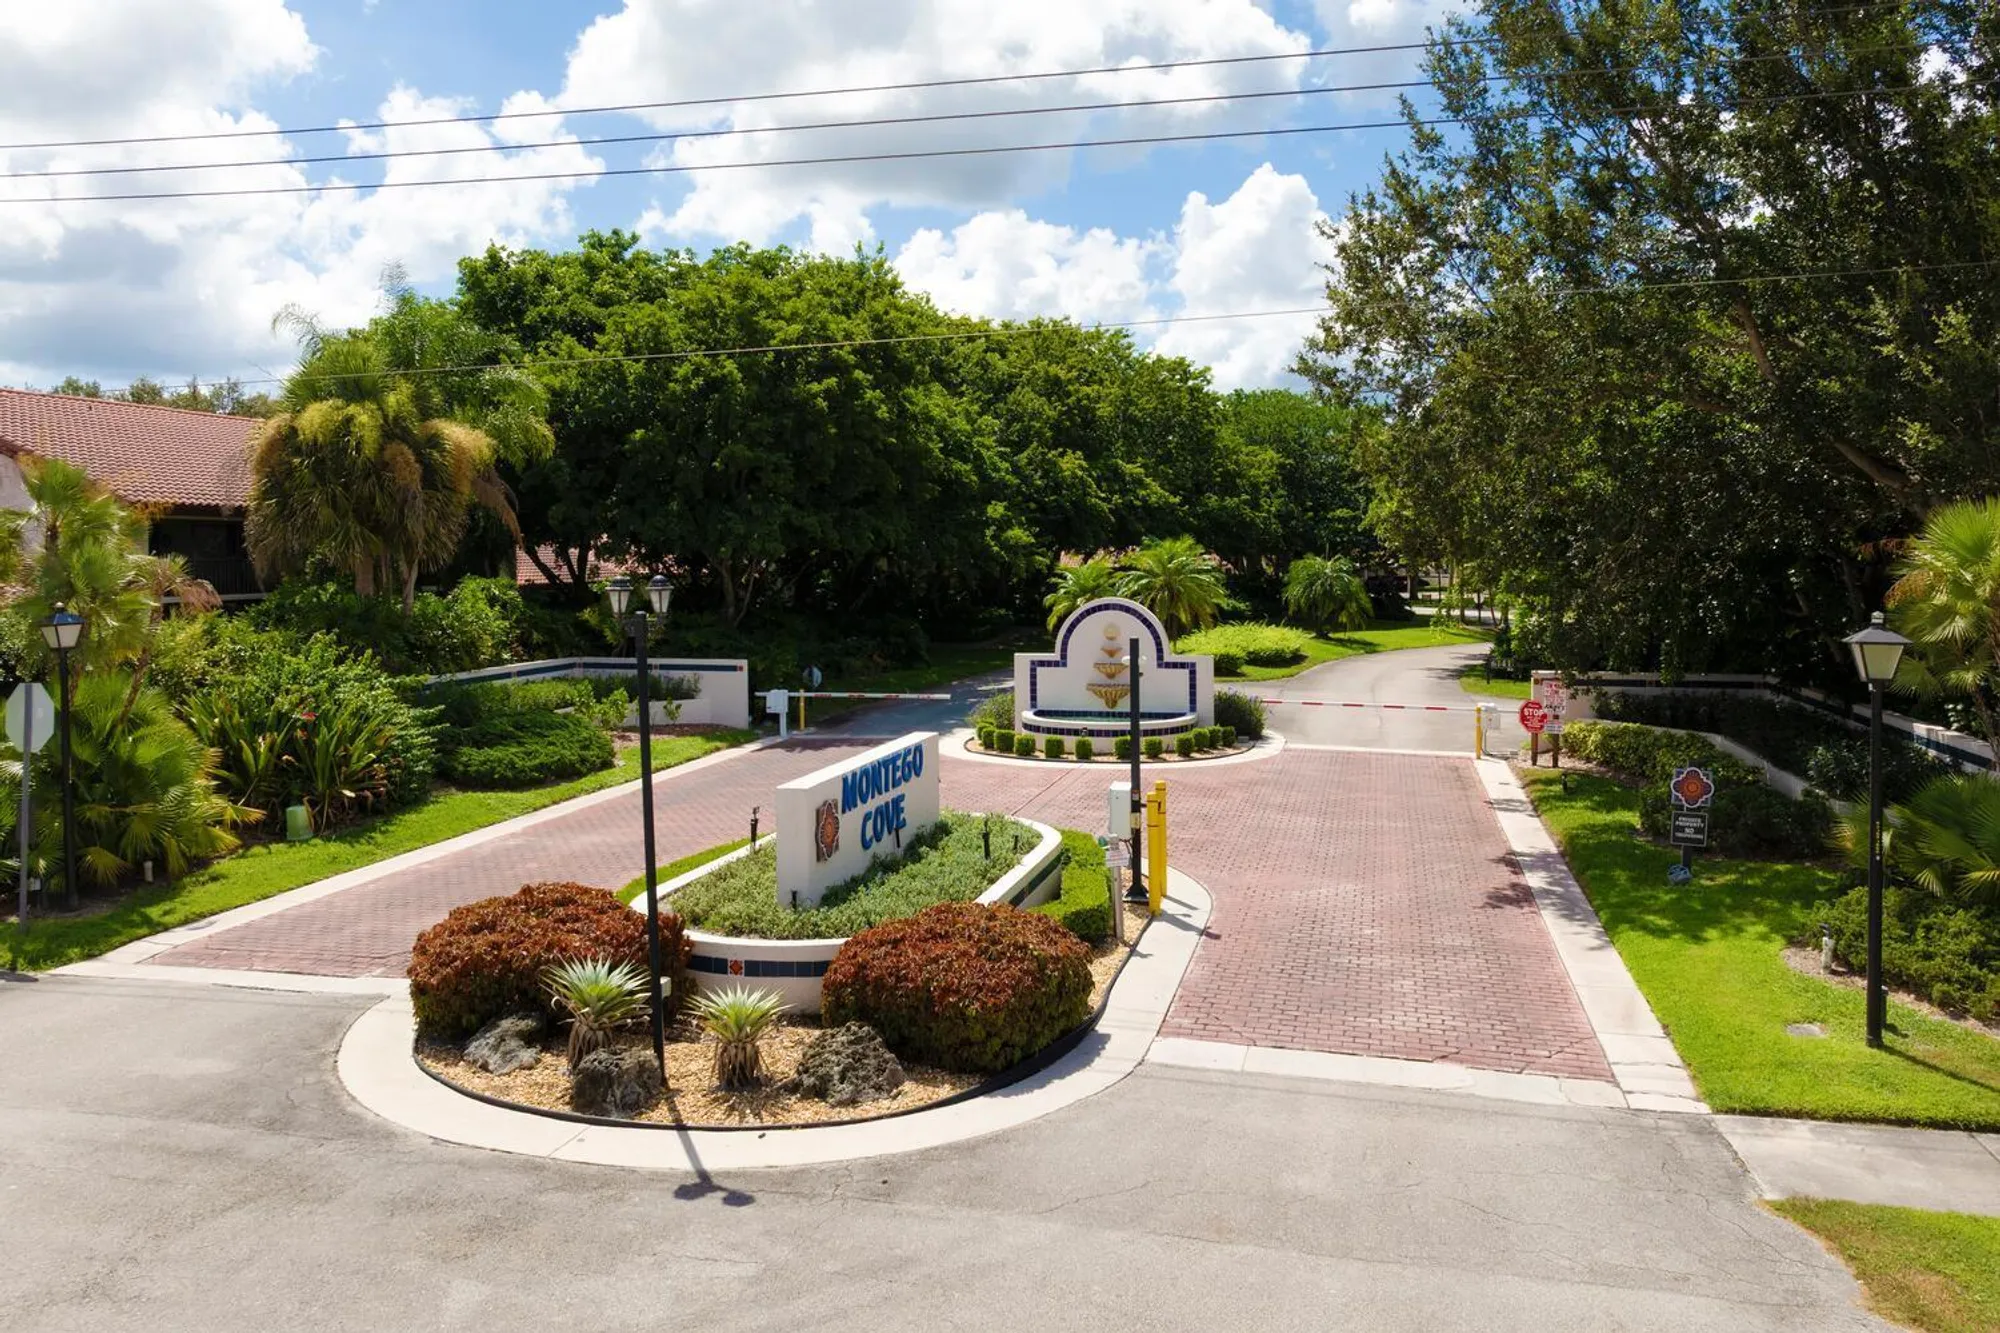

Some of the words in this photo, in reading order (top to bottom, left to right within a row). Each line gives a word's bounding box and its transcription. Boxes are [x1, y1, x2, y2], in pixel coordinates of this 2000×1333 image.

[1524, 708, 1543, 716] STOP
[841, 743, 924, 815] MONTEGO
[860, 793, 907, 851] COVE
